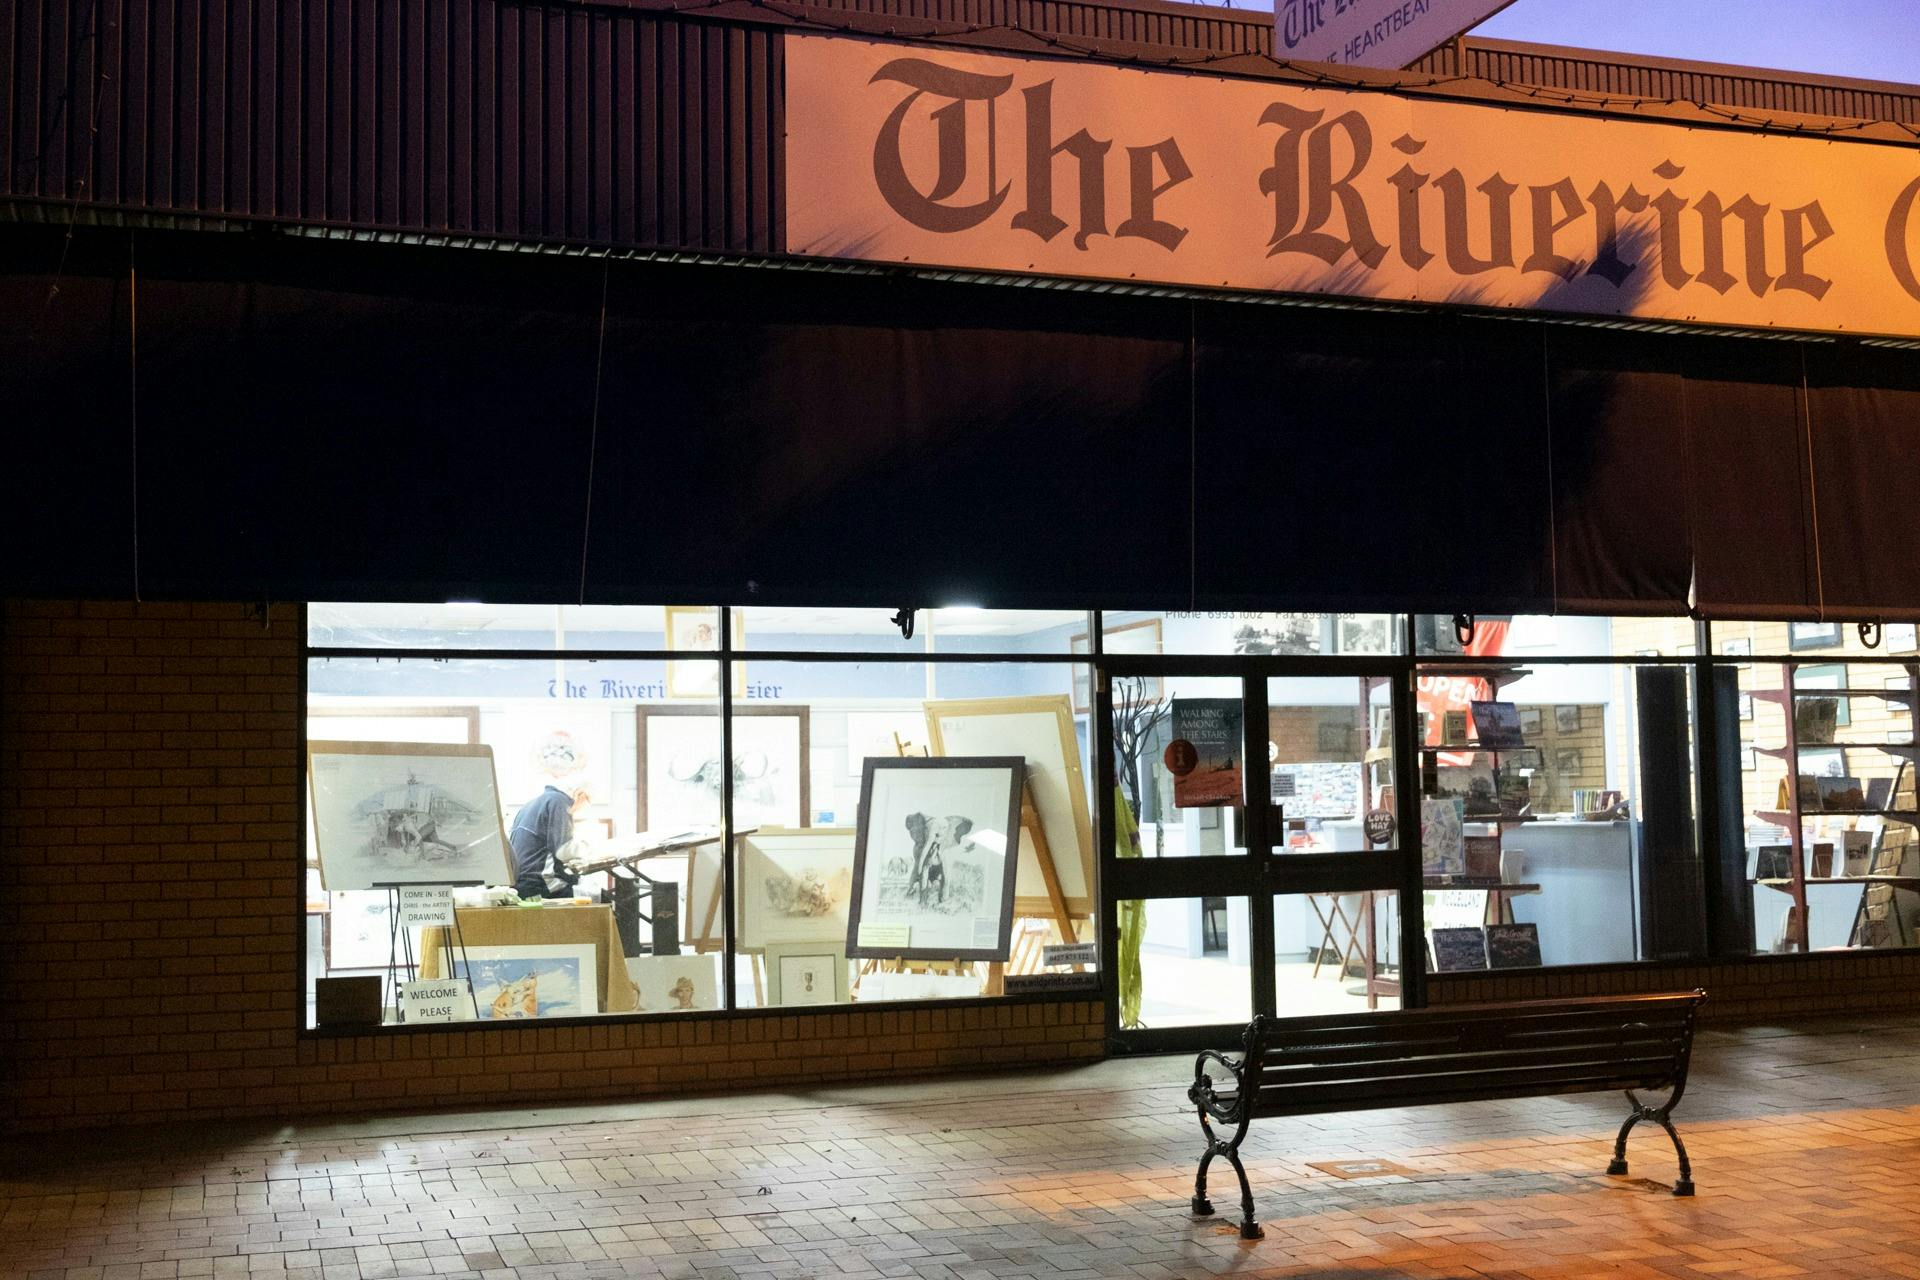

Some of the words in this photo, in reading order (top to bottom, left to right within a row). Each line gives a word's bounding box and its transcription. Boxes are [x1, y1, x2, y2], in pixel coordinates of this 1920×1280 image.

[867, 57, 1194, 253] The
[1257, 101, 1834, 302] Riverine
[599, 680, 665, 698] Riveri
[747, 680, 783, 698] zier
[1180, 708, 1224, 718] WALKING
[1181, 719, 1218, 729] AMONG
[1181, 730, 1199, 739] THE
[1201, 730, 1228, 739] STARS
[1367, 813, 1391, 823] LOVE
[1370, 822, 1389, 830] HAY
[408, 912, 446, 922] DRAWING
[410, 988, 458, 1000] WELCOME
[420, 1006, 452, 1017] PLEASE
